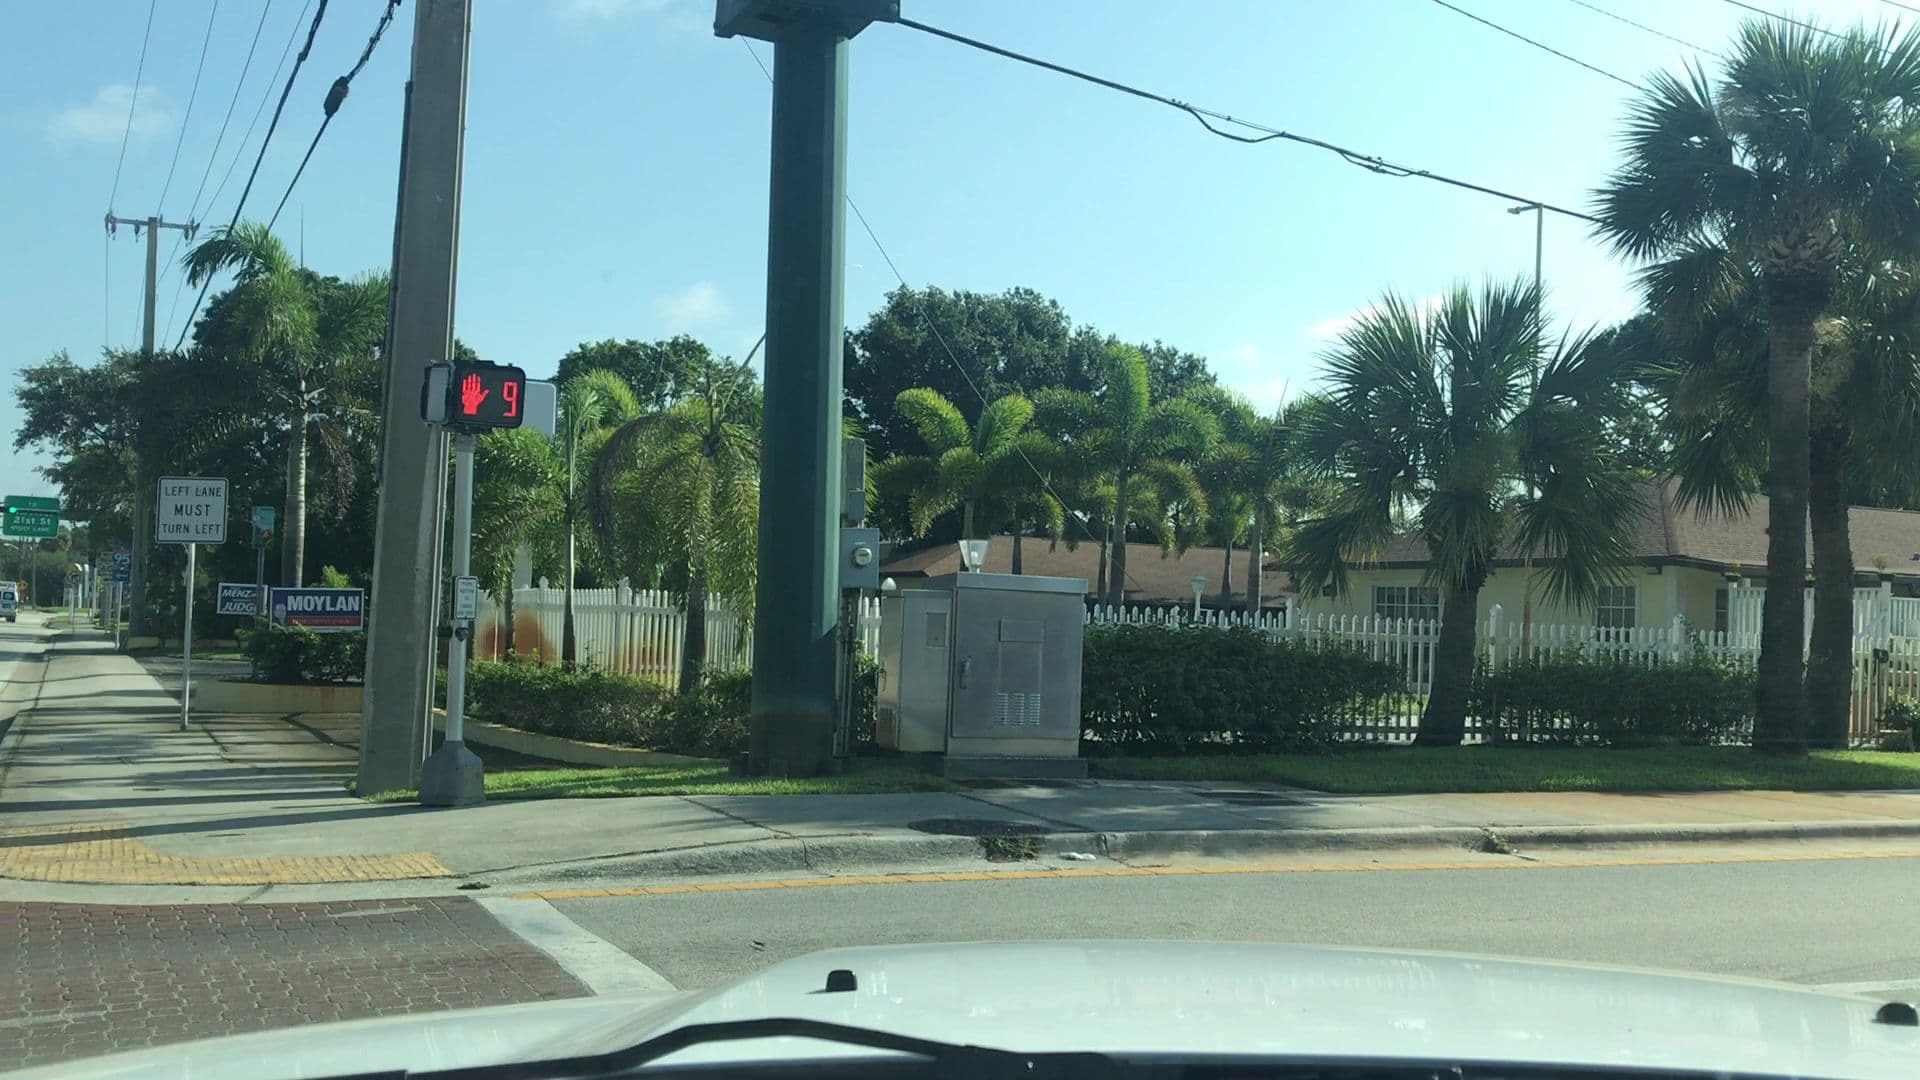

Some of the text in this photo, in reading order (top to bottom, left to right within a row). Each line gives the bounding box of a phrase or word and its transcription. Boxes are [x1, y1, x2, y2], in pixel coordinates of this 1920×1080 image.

[503, 381, 518, 417] 9
[165, 486, 222, 497] LEFT LANE
[174, 504, 211, 516] MUST
[14, 515, 36, 525] 21st
[162, 523, 221, 535] TURN LEFT
[113, 552, 130, 565] 95
[287, 594, 360, 612] MOYLAN
